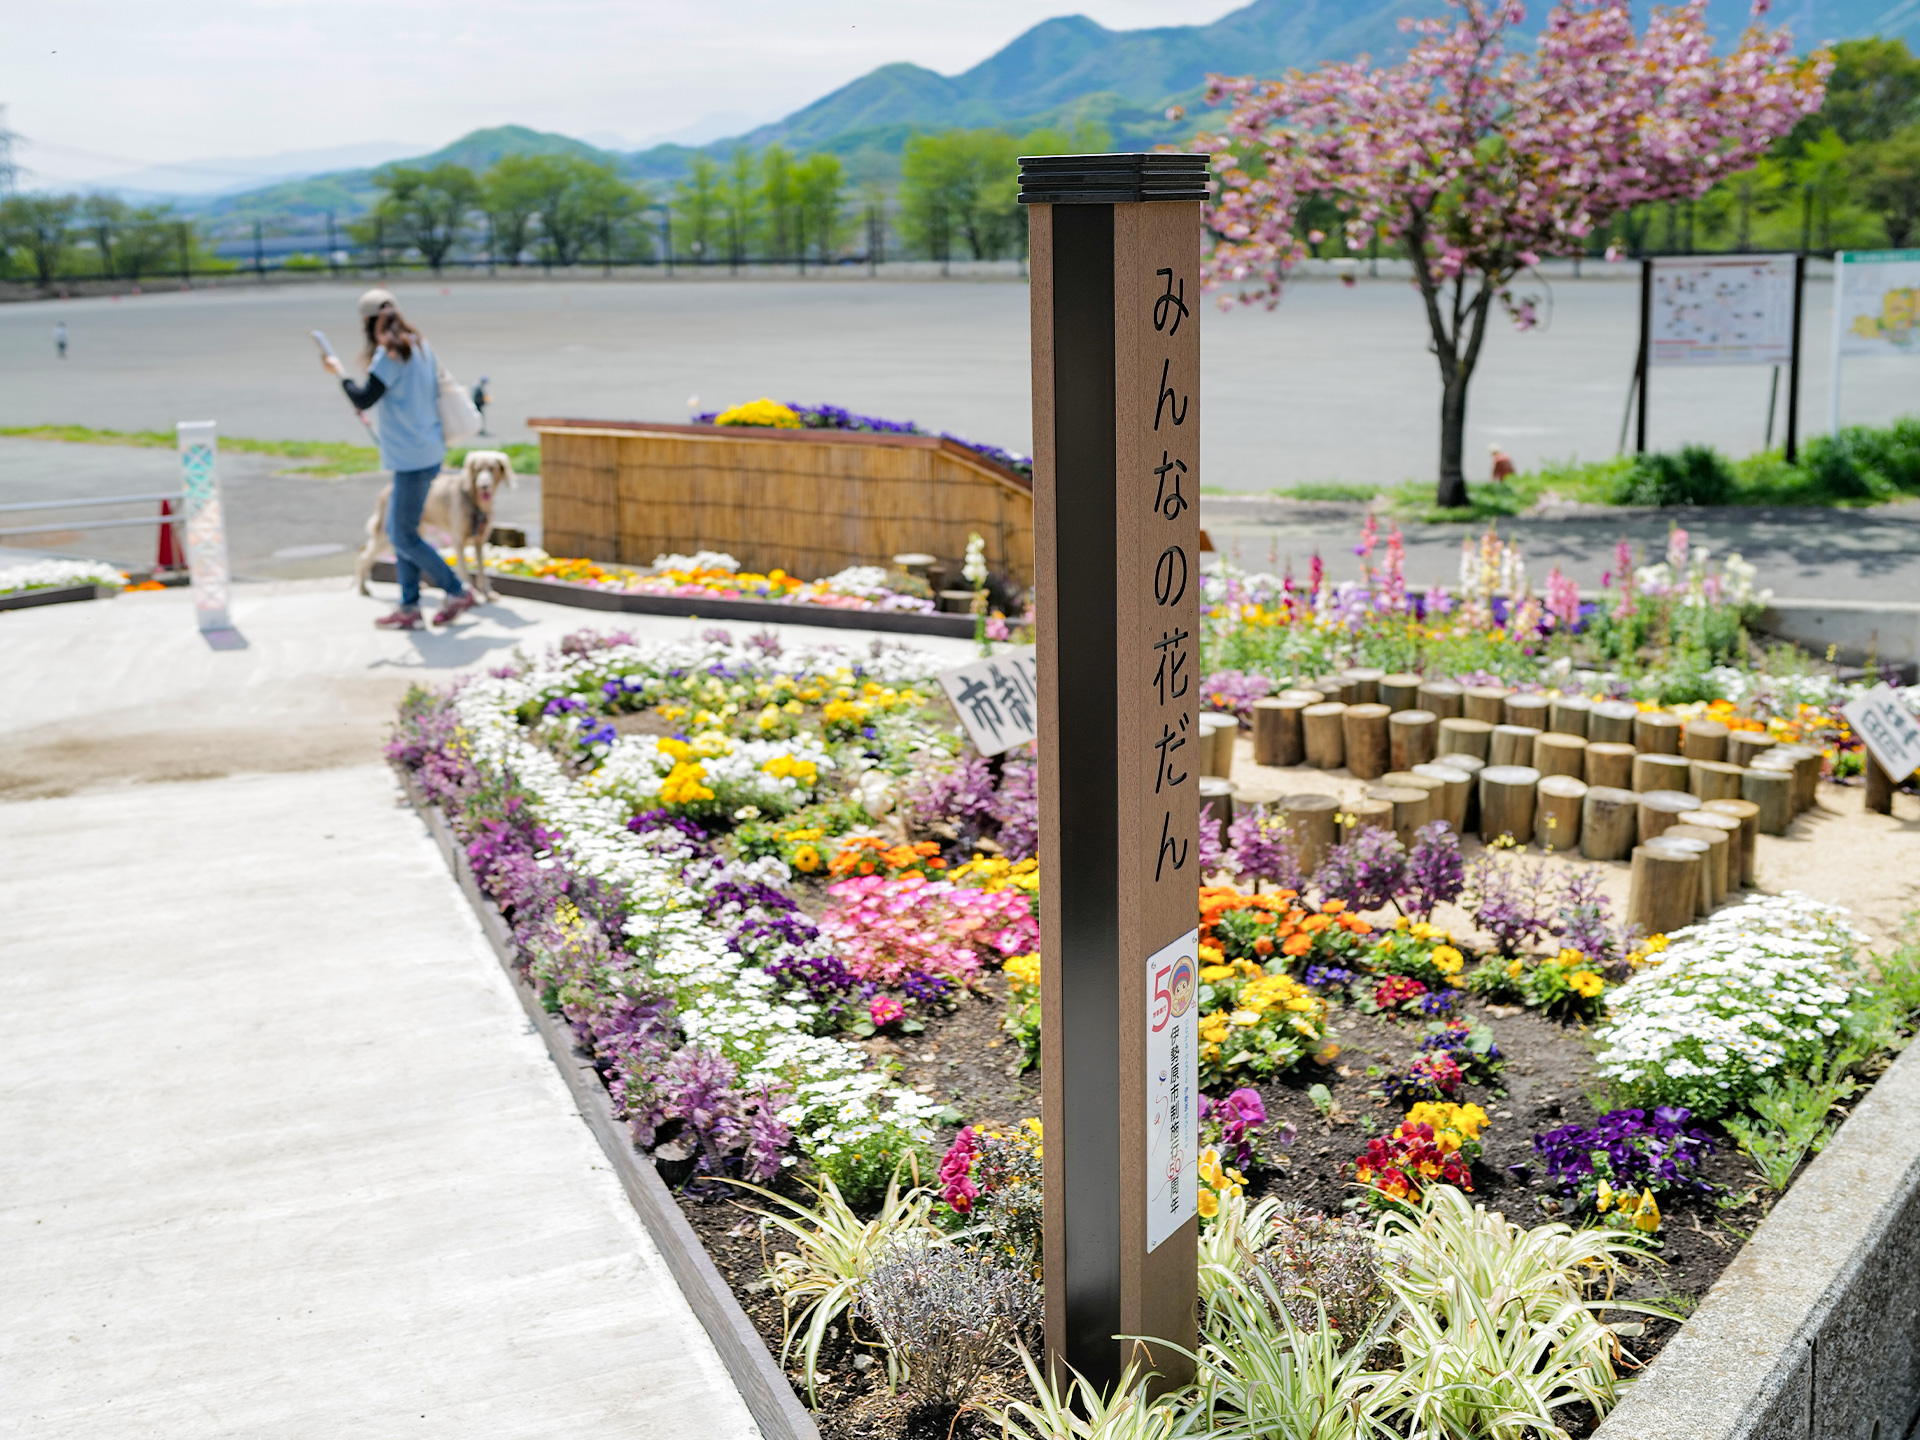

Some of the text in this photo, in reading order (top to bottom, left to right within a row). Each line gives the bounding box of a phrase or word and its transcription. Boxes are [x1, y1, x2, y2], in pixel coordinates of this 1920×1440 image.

[957, 658, 1036, 746] 市制
[1153, 267, 1189, 882] みんなの花だん
